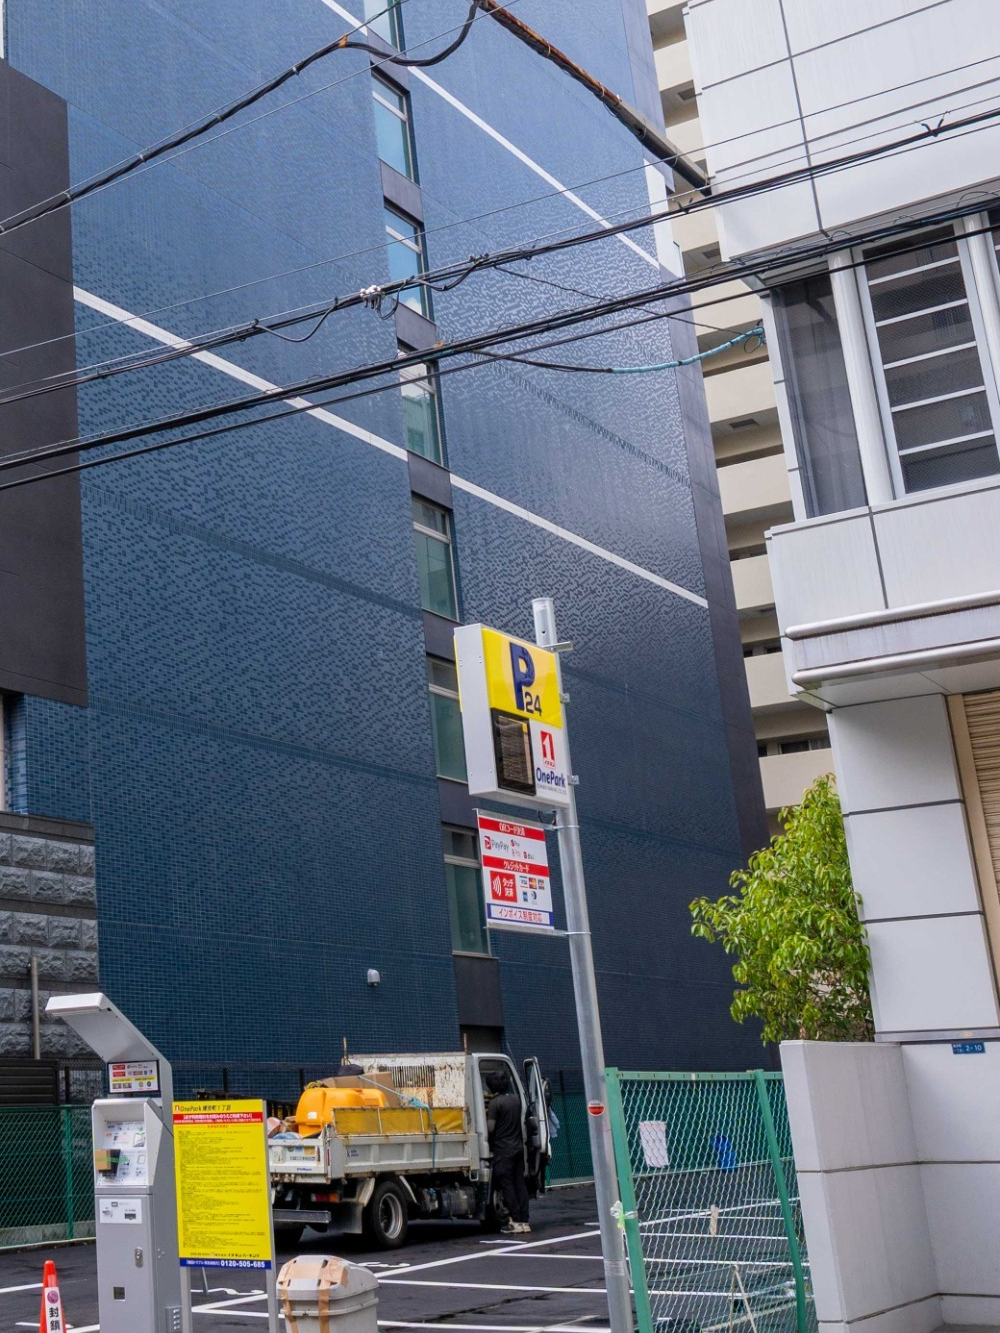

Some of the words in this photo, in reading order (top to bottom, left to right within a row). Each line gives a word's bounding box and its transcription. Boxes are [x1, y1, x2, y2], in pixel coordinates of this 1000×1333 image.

[509, 642, 535, 711] P
[524, 691, 543, 717] 24
[536, 767, 566, 788] OnePark
[220, 1260, 265, 1268] 0120-505-685
